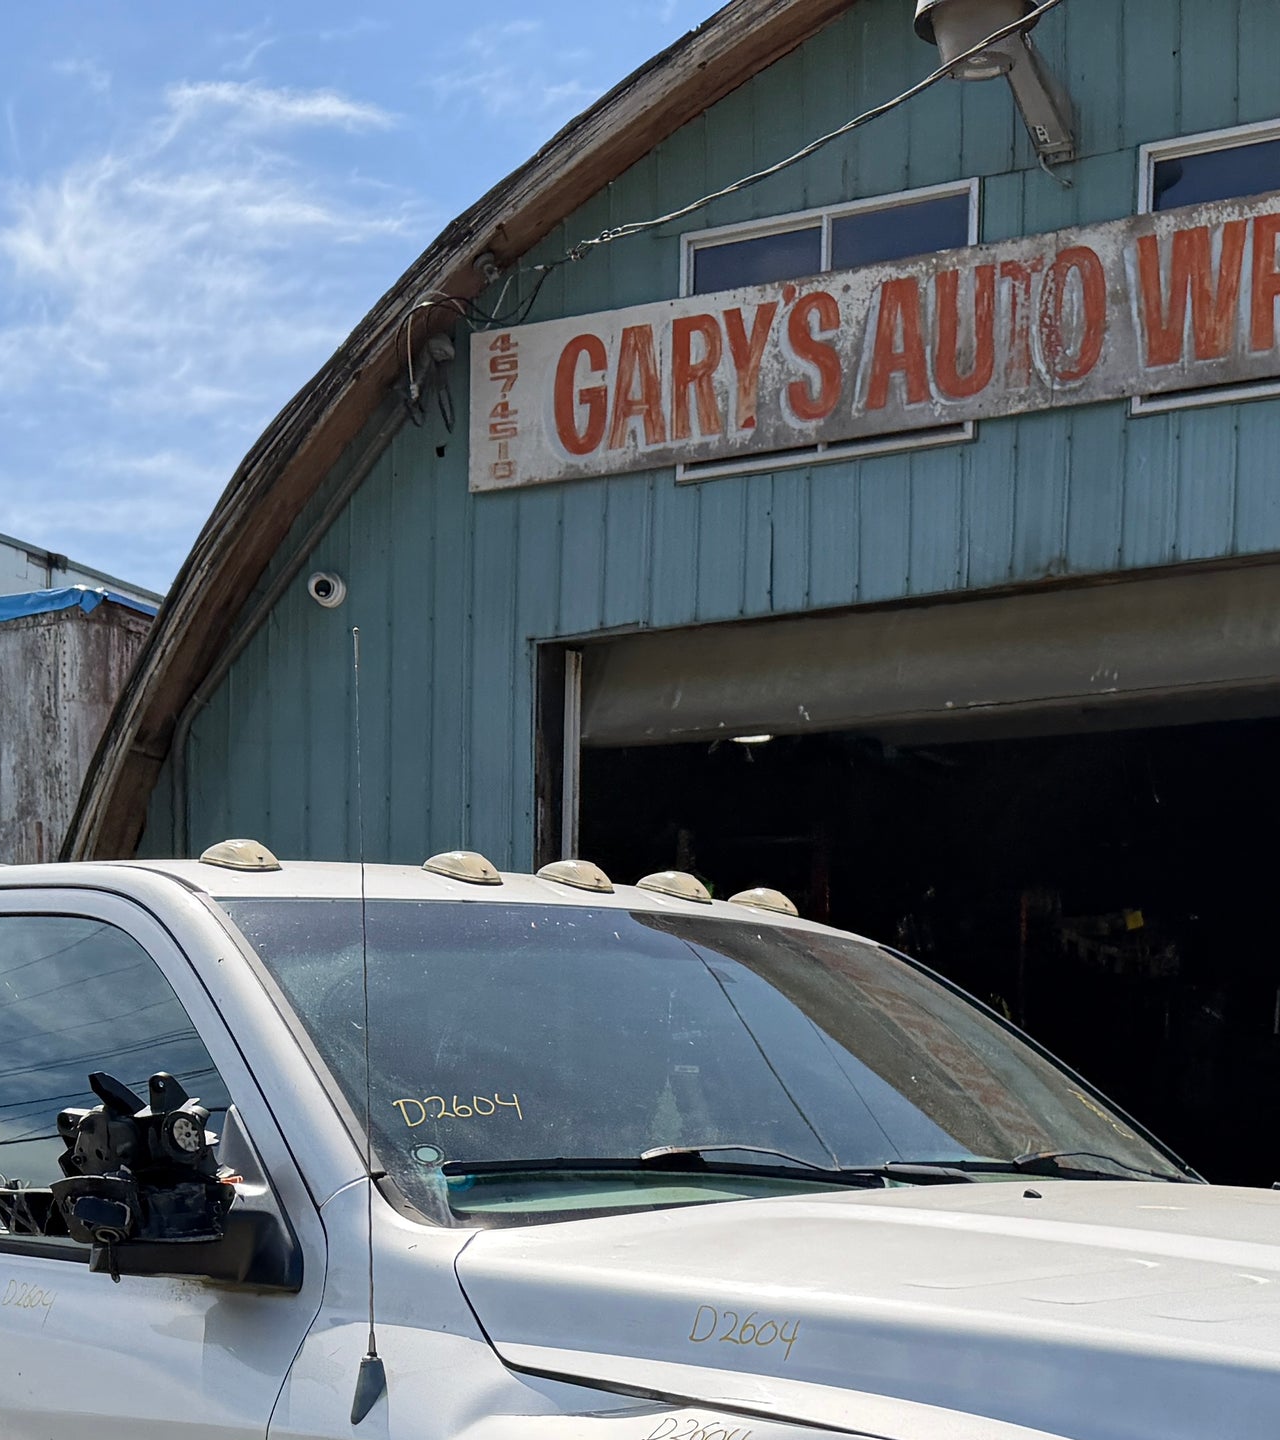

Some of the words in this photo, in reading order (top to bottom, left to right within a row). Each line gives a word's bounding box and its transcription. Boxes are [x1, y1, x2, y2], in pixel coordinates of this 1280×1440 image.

[552, 283, 841, 456] GARY'S
[860, 244, 1108, 411] AUTO
[391, 1092, 523, 1128] D2604
[688, 1304, 801, 1361] D2604
